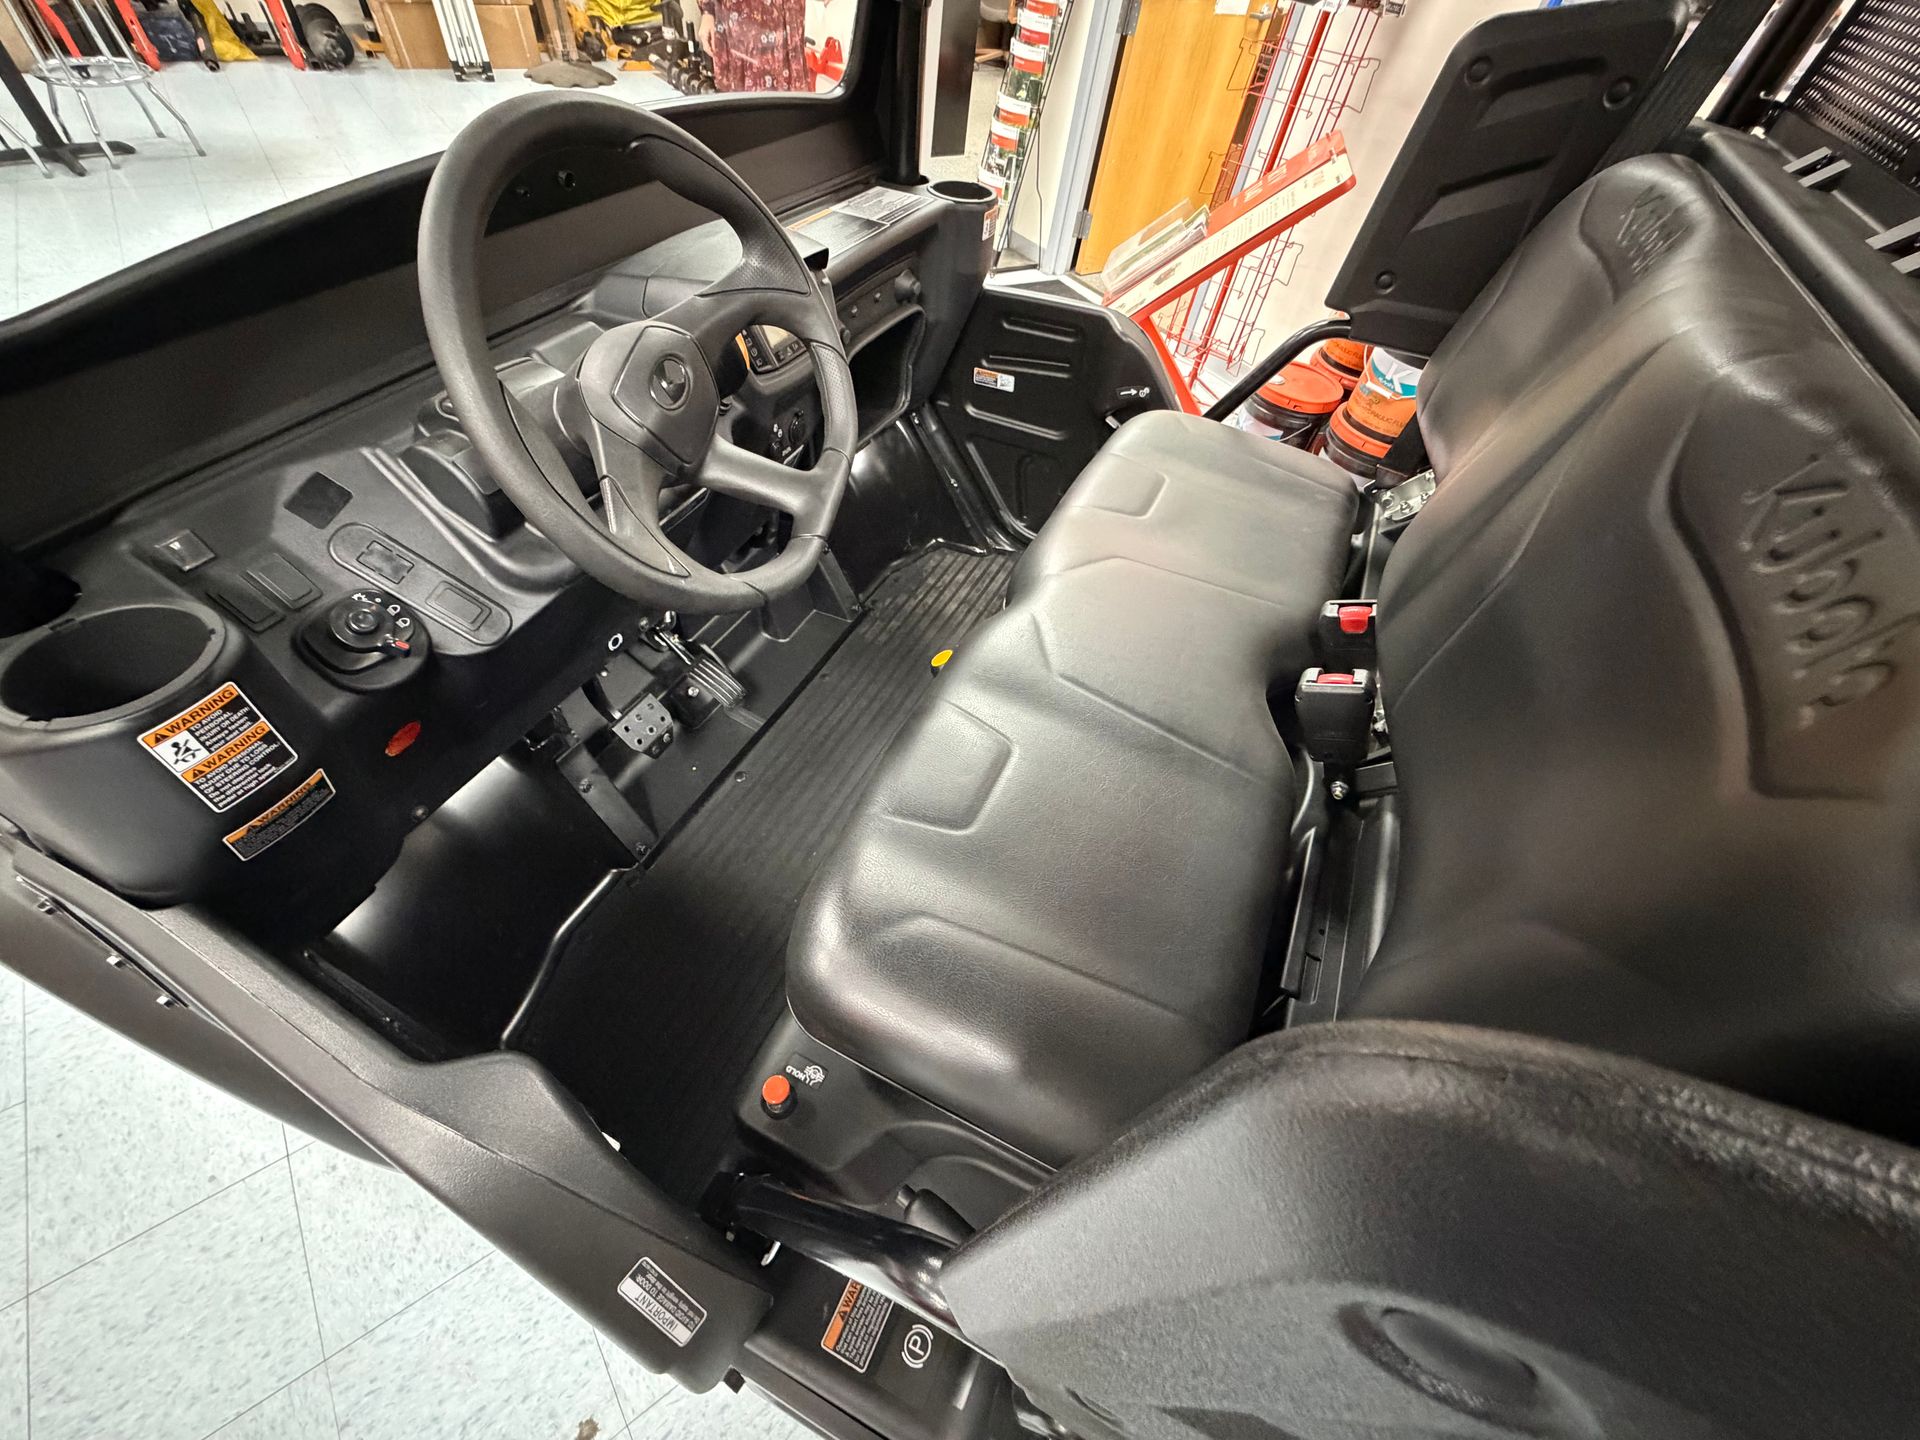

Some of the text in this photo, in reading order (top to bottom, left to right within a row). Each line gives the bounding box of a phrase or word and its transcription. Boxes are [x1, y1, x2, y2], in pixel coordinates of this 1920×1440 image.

[1740, 453, 1920, 728] Kubota
[164, 688, 234, 735] WARNING
[189, 709, 223, 731] TO AVOID
[194, 710, 233, 736] PERSONAL
[198, 725, 221, 741] INJURY
[219, 719, 230, 728] OR
[204, 715, 248, 746] Always fasten
[209, 740, 226, 752] your
[224, 729, 240, 741] seat
[194, 776, 206, 785] TO
[205, 762, 228, 779] AVOID
[226, 739, 263, 765] PERSONAL
[201, 724, 266, 770] WARNING
[198, 743, 268, 790] INJURY DUE TO LOSS
[203, 785, 216, 794] OF
[214, 763, 249, 787] STEERING
[208, 765, 257, 798] Do not depress
[212, 793, 226, 803] the
[224, 771, 259, 796] differential
[256, 762, 271, 773] lock
[217, 793, 237, 807] pedal
[242, 778, 259, 791] high
[257, 781, 311, 824] WARNING
[786, 1065, 806, 1082] HOLD
[649, 1286, 658, 1296] TO
[655, 1291, 677, 1313] DAMAGE
[634, 1290, 678, 1331] IMPORTANT
